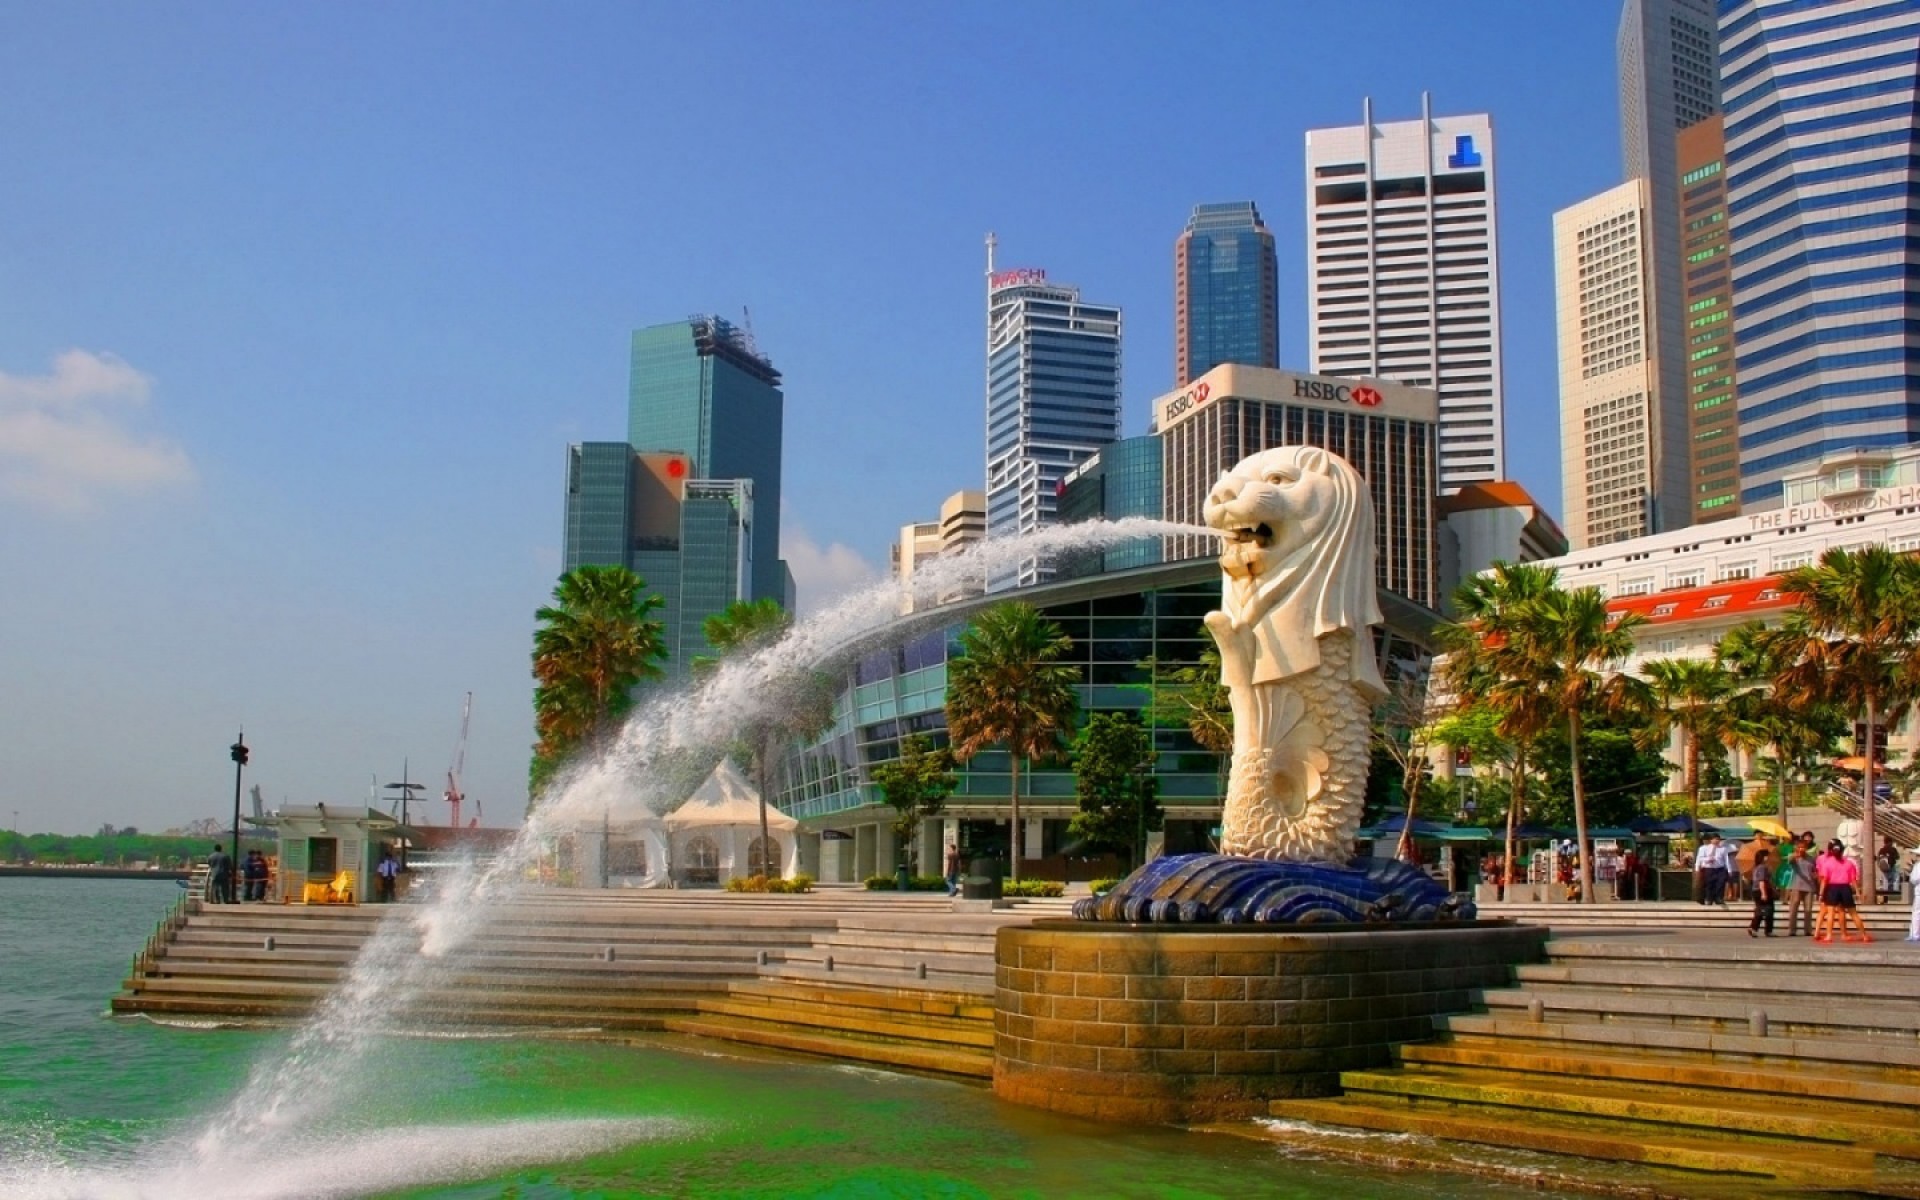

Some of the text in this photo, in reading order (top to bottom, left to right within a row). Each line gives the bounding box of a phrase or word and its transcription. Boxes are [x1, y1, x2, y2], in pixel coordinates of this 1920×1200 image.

[1166, 390, 1194, 422] HSBC
[1293, 379, 1350, 403] HSBC
[1748, 512, 1782, 530] THE
[1789, 493, 1892, 524] FULLERTON
